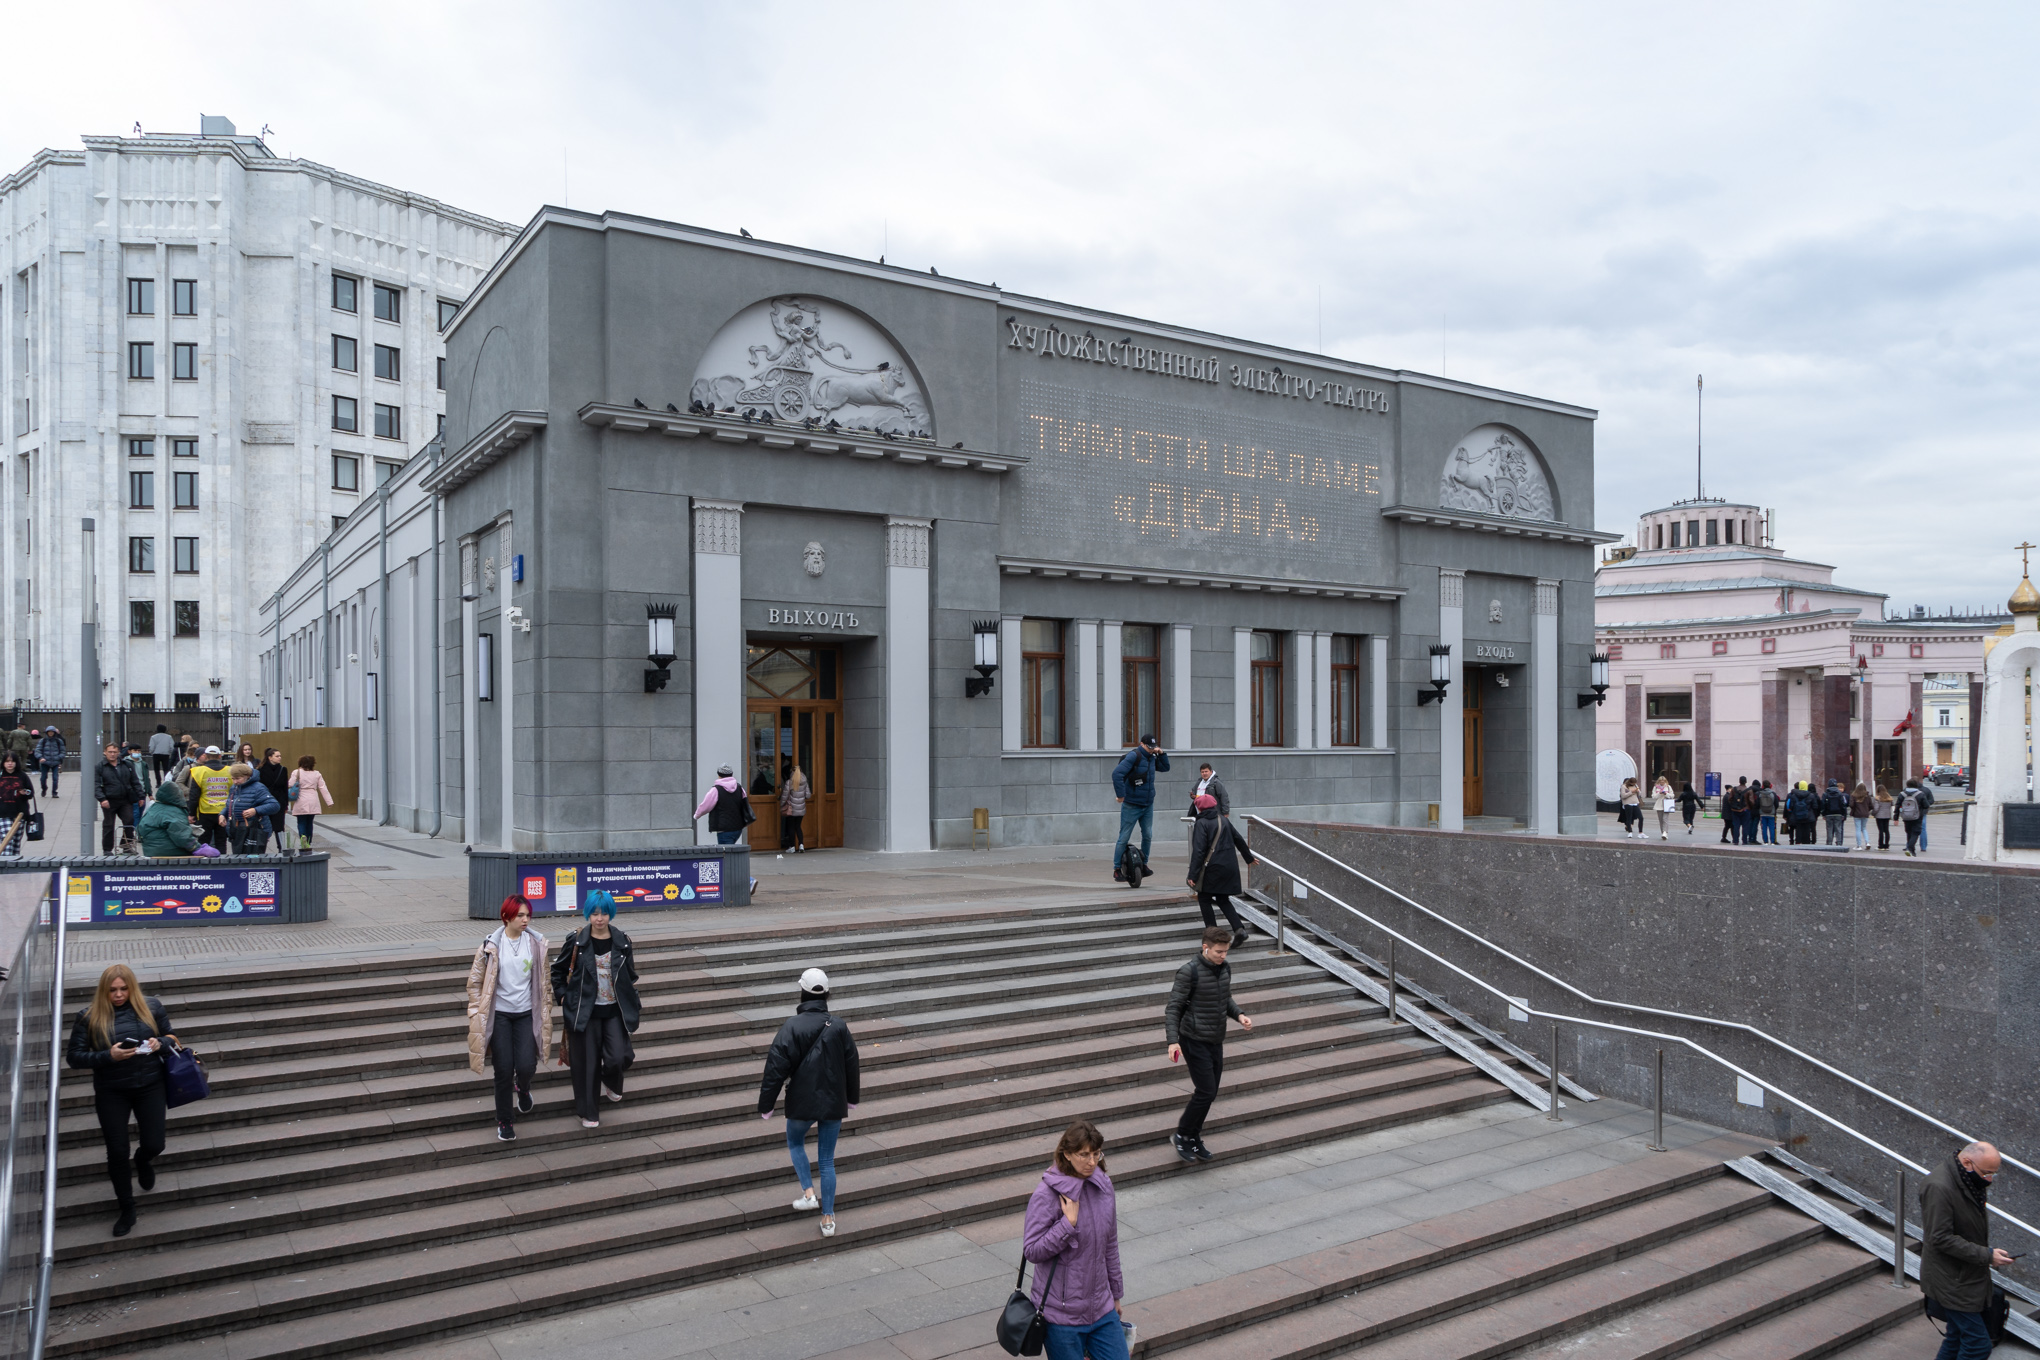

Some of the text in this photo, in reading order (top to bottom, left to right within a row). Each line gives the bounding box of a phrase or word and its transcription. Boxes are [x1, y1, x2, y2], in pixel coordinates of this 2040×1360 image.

[1008, 321, 1390, 414] ХУДОЖЕСТВЕННЫЙ ЭЛЕКТРО-ТЕАТРЪ
[1030, 415, 1380, 495] ТИМОТИ ШАЛАМЕ
[1111, 482, 1320, 543] «ДЮНА»
[768, 608, 859, 630] ВЫХОДЪ
[1477, 645, 1515, 660] ВХОДЪ
[633, 864, 671, 872] помощник
[104, 873, 211, 882] Ваш личный помощник
[592, 874, 645, 883] путешествиях
[112, 883, 178, 893] путешествиях
[192, 882, 225, 890] России
